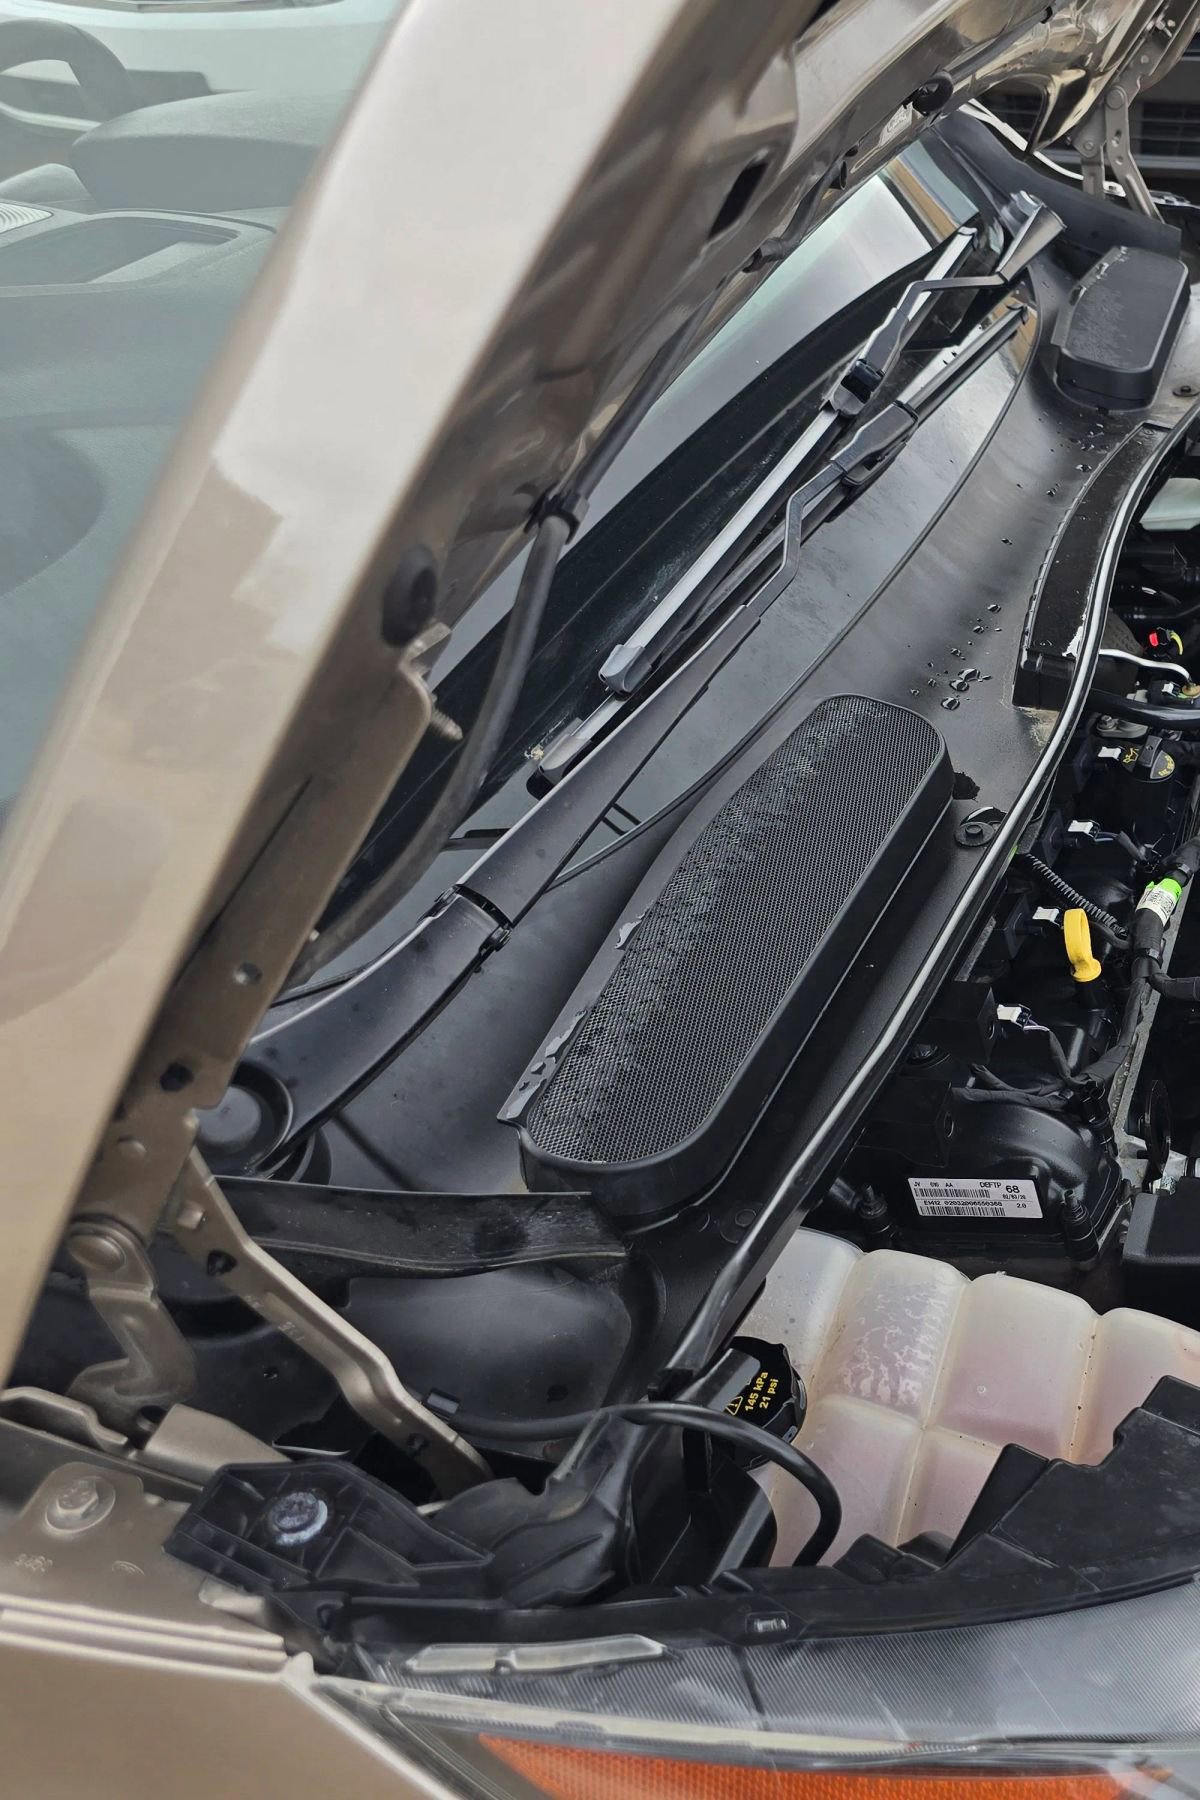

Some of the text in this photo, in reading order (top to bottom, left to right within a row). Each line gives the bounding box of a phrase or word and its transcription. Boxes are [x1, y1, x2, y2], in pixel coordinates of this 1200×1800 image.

[1005, 1184, 1020, 1194] 68
[744, 1371, 769, 1411] 145 kPa
[759, 1378, 779, 1409] 21 psi
